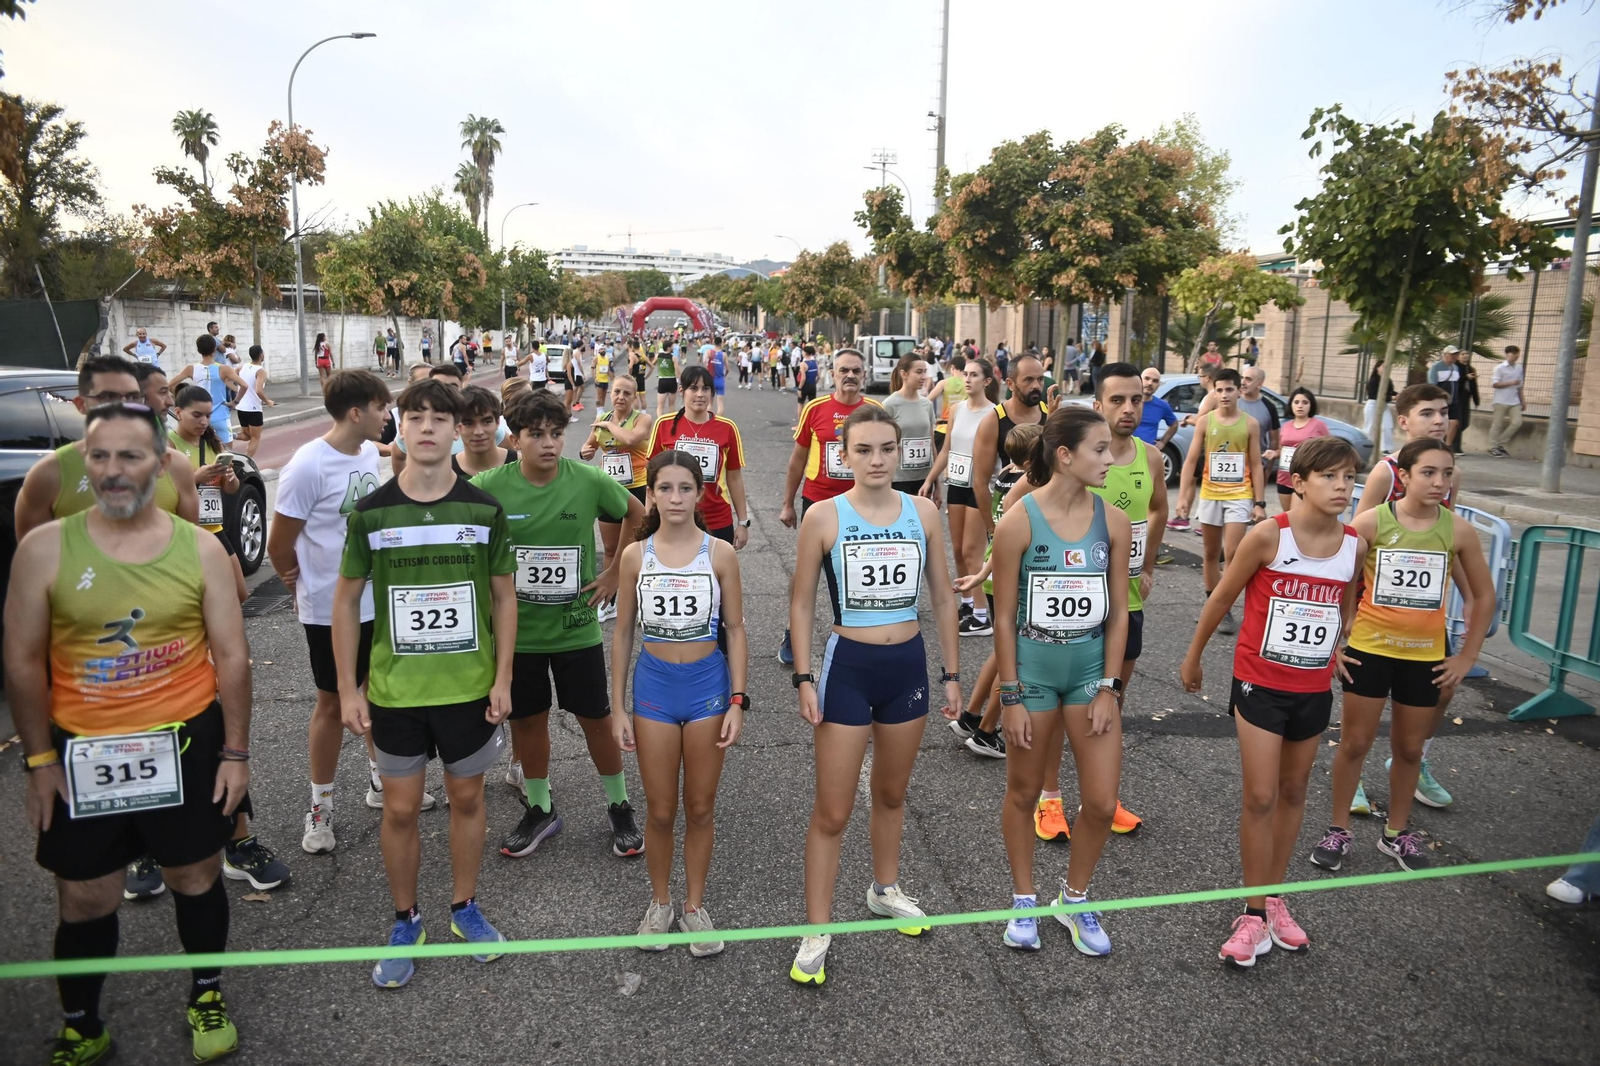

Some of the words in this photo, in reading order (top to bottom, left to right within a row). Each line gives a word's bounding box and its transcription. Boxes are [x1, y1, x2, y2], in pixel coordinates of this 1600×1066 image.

[908, 448, 926, 458] 311
[608, 464, 625, 476] 314
[950, 462, 964, 475] 310
[1217, 462, 1238, 472] 321
[204, 499, 220, 512] 301
[388, 555, 430, 568] TLETISMO
[527, 566, 566, 585] 329
[861, 563, 907, 587] 316
[1391, 569, 1431, 588] 320
[1272, 579, 1341, 604] CURTIUS
[653, 595, 698, 617] 313
[1045, 597, 1092, 617] 309
[410, 608, 459, 631] 323
[1282, 622, 1327, 646] 319
[94, 758, 158, 786] 315
[114, 799, 128, 808] 3k
